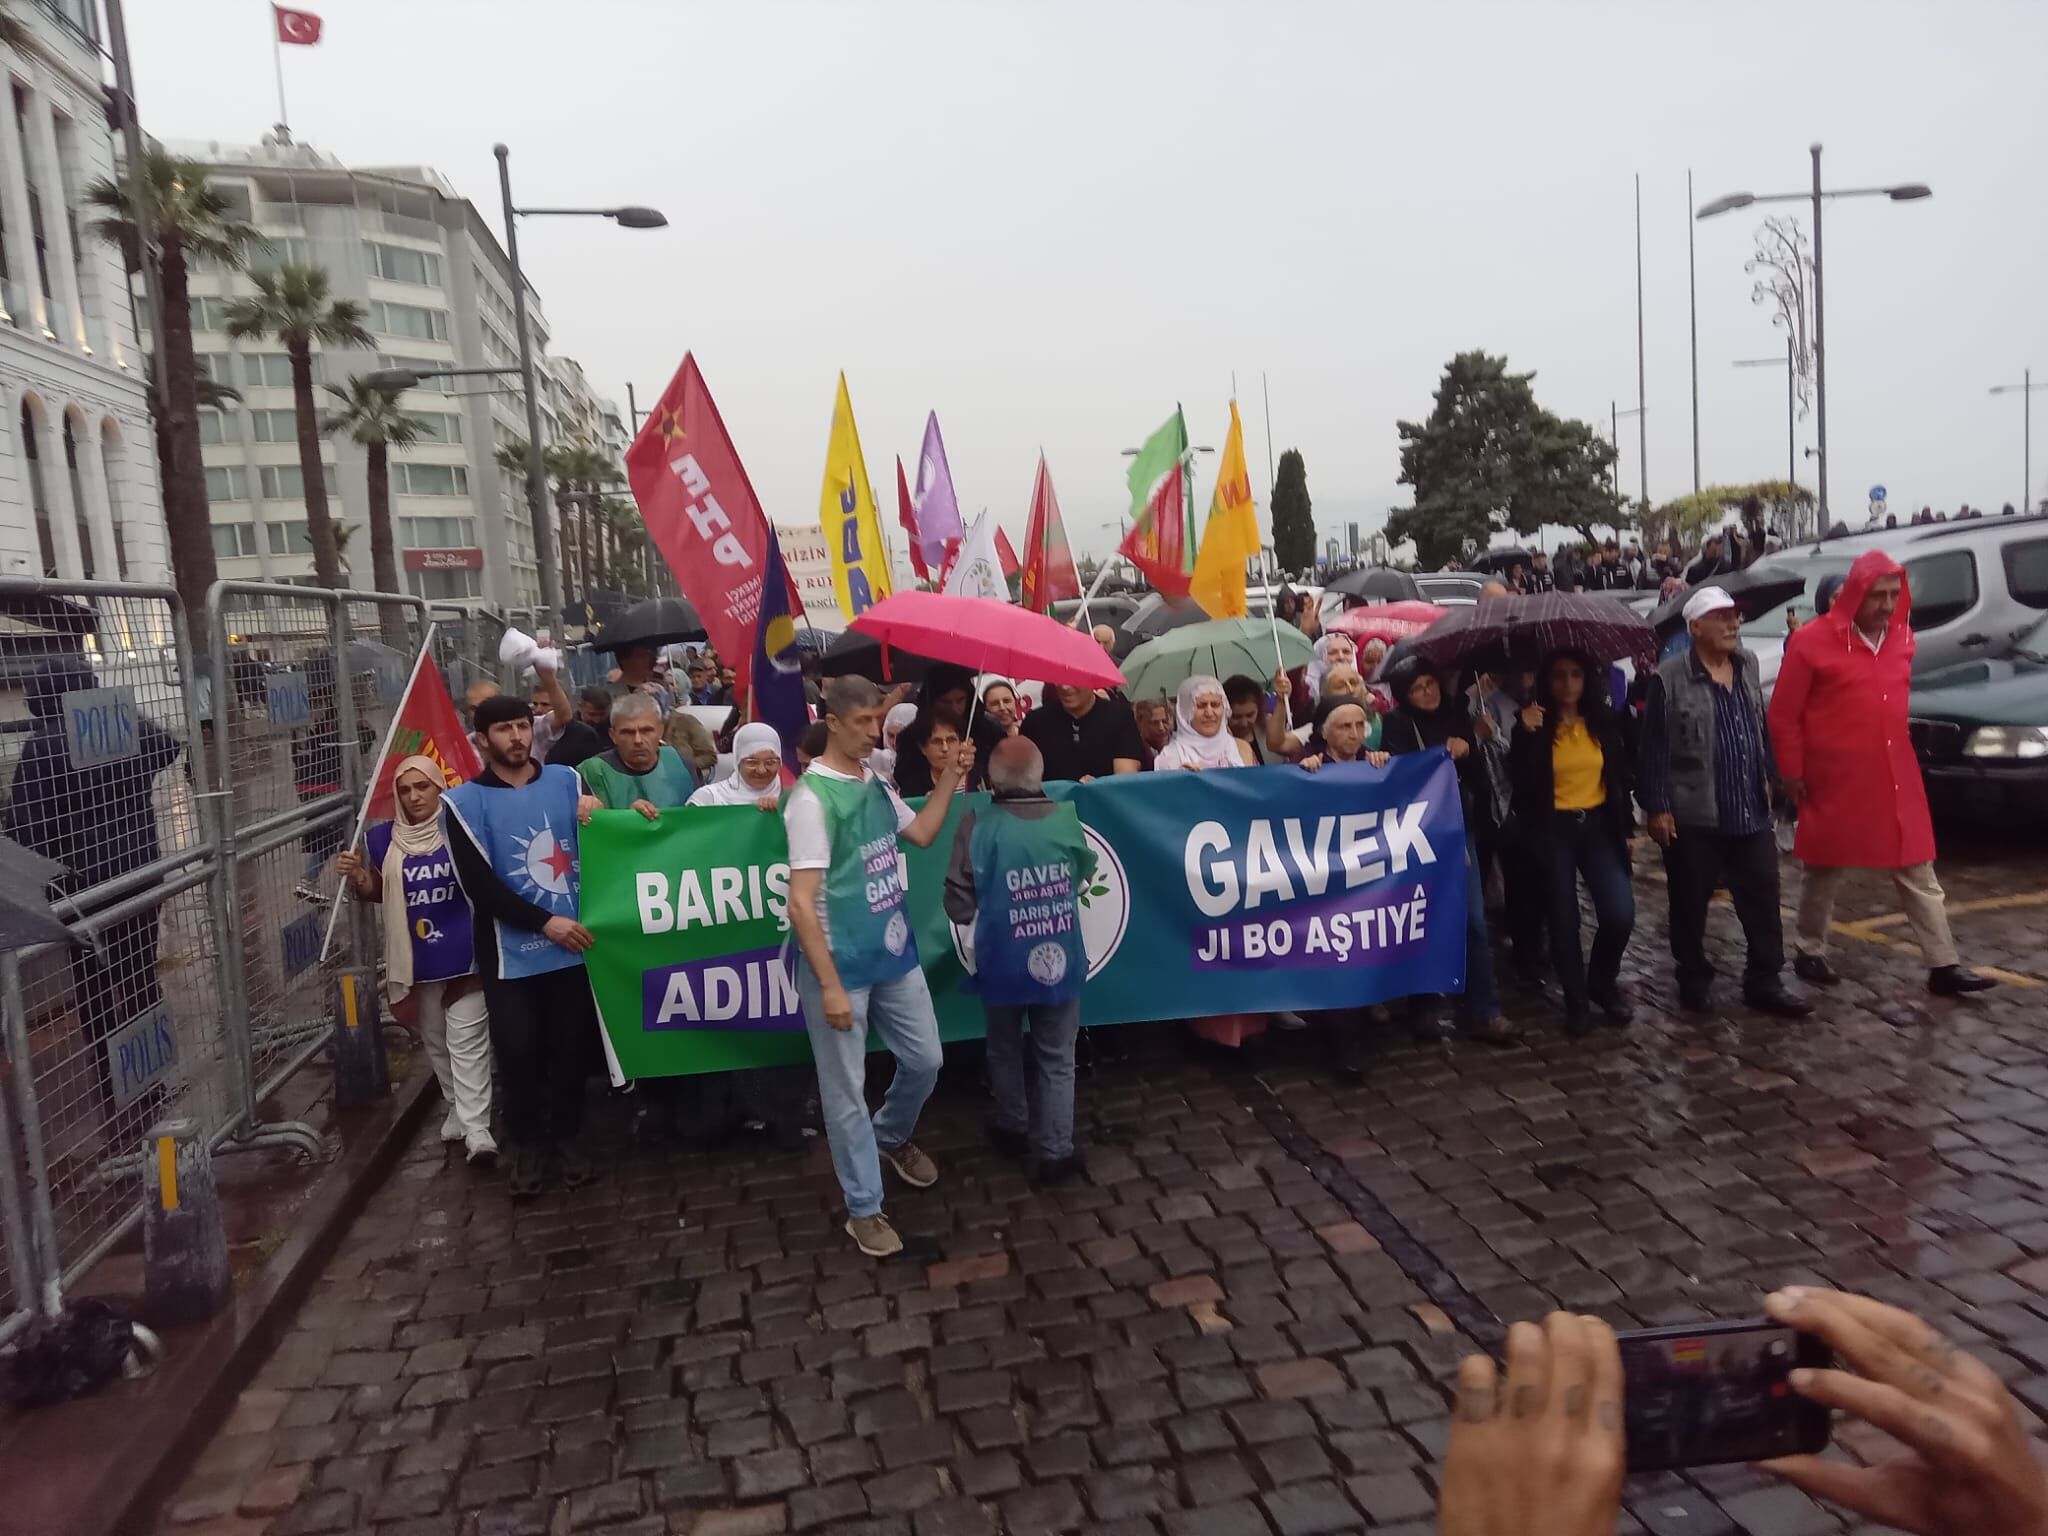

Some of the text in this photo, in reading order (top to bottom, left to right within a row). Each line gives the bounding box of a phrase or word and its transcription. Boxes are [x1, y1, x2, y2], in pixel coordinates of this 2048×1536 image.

[404, 862, 450, 882] YAN
[1185, 800, 1437, 917] GAVEK
[1006, 862, 1072, 891] GAVEK
[636, 863, 791, 935] BARIŞ
[1009, 904, 1050, 925] BARIŞ
[1015, 913, 1073, 939] ADIM AT
[1197, 884, 1428, 962] JI BO AŞTIYÊ
